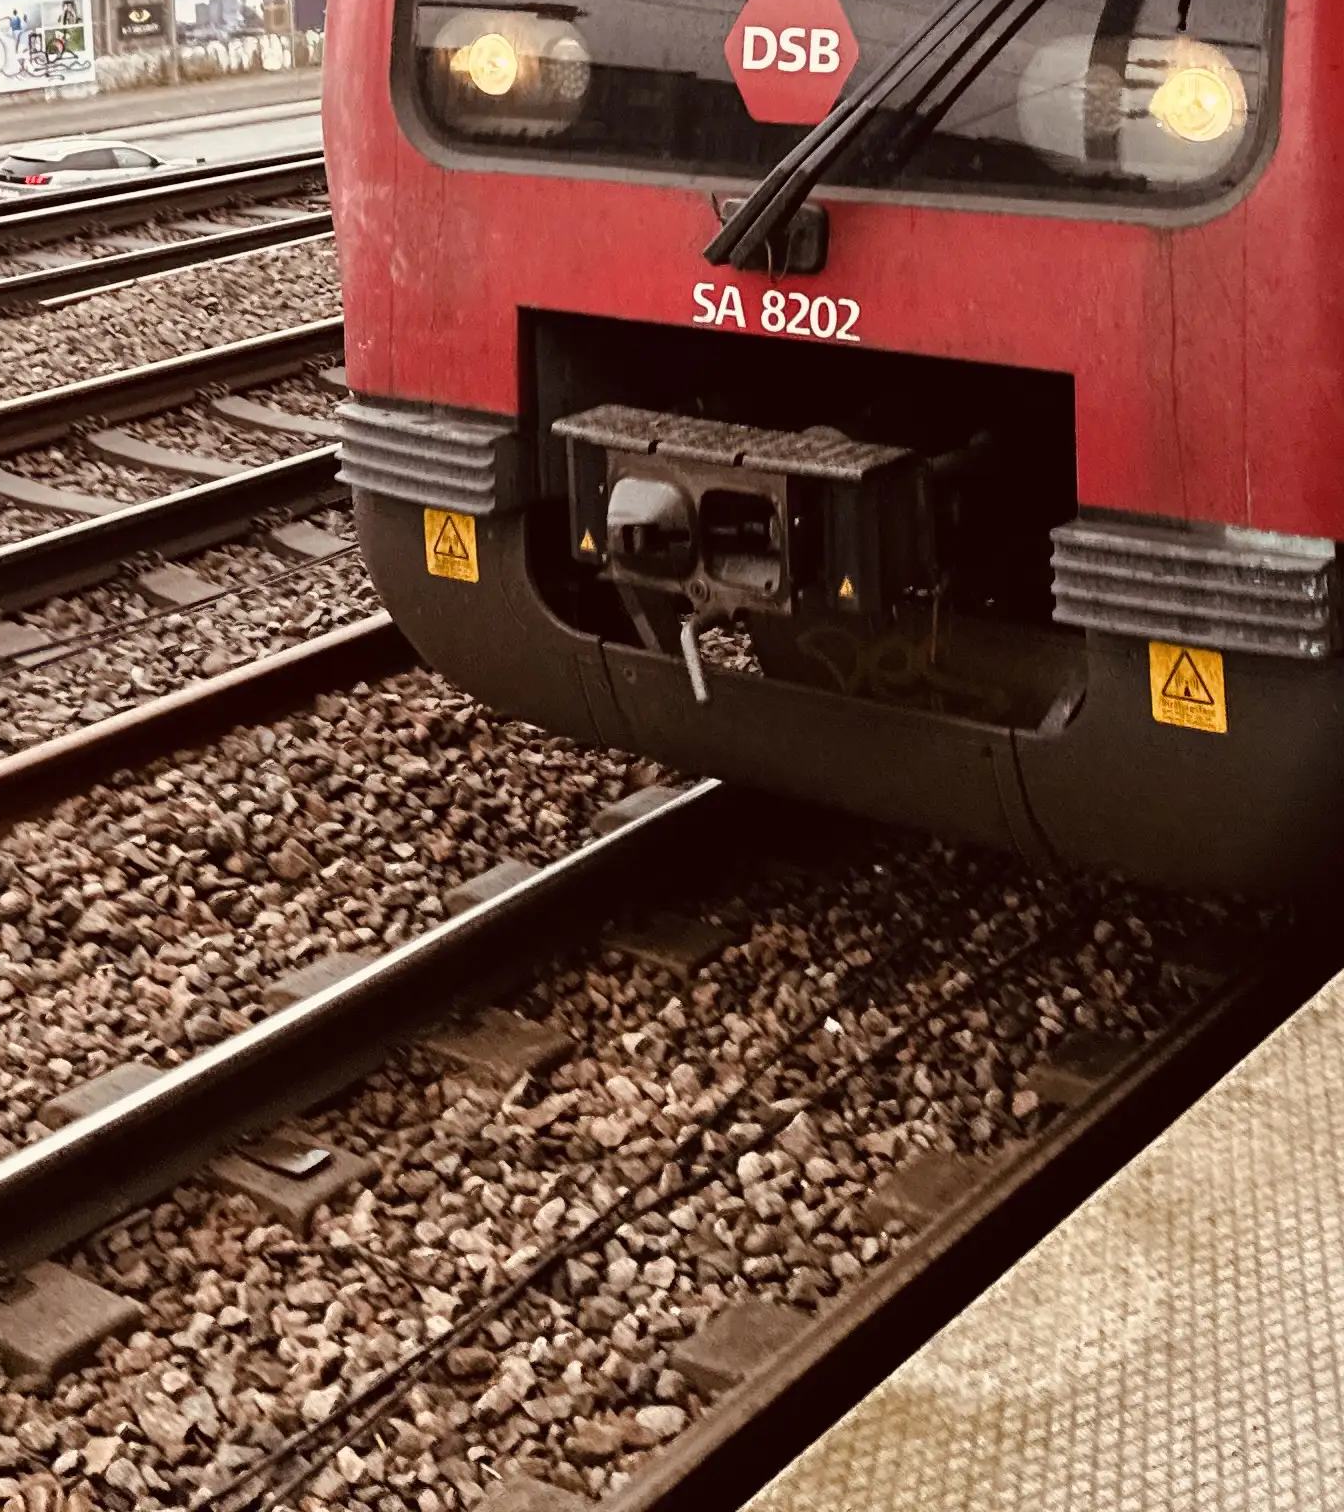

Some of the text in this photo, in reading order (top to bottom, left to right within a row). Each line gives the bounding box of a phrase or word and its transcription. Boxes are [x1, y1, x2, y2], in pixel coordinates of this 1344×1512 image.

[742, 26, 840, 73] DSB
[692, 282, 861, 342] SA 8202
